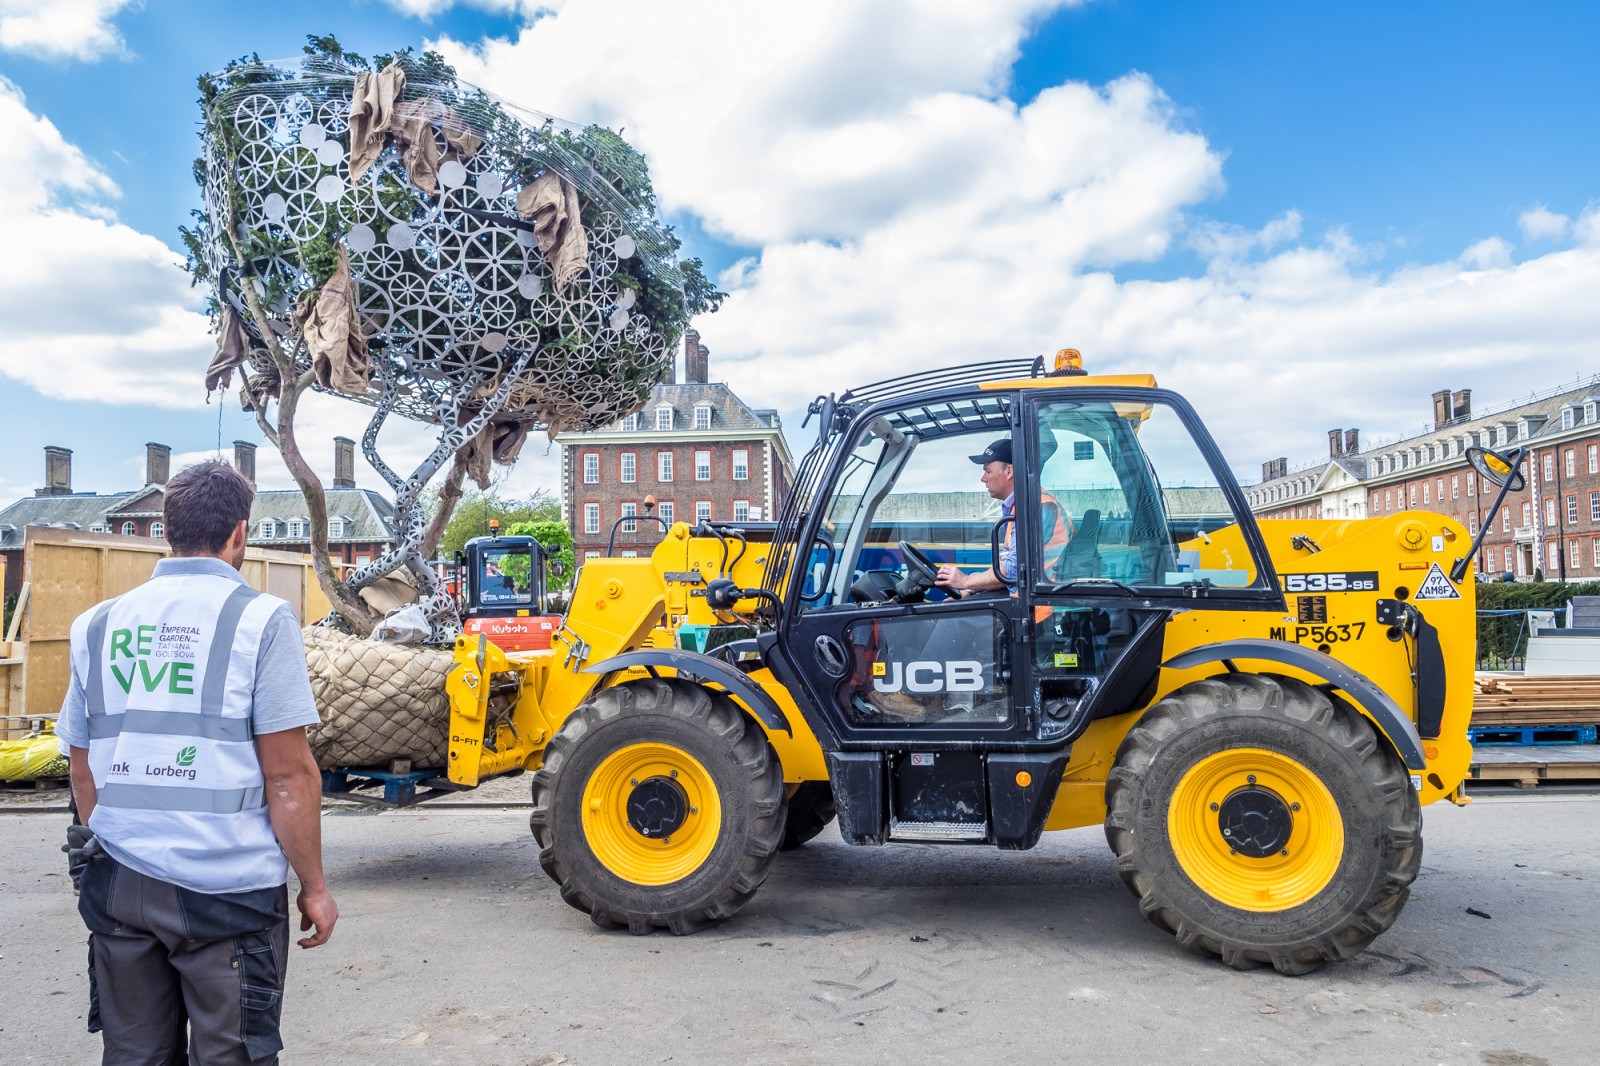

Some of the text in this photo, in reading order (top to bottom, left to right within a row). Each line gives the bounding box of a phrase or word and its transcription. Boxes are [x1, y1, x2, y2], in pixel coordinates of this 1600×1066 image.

[1286, 573, 1374, 591] 535-95
[1430, 576, 1442, 585] 97
[1424, 585, 1449, 595] AM8F
[160, 623, 201, 635] IMPERIAL
[492, 624, 528, 633] Kubota
[1270, 621, 1366, 644] MLP5637
[110, 625, 157, 661] RE
[159, 634, 192, 642] GARDEN
[157, 642, 191, 650] TATYANA
[155, 650, 195, 659] GOLTSOVA
[873, 660, 984, 693] JCB
[145, 764, 197, 780] Lorberg
